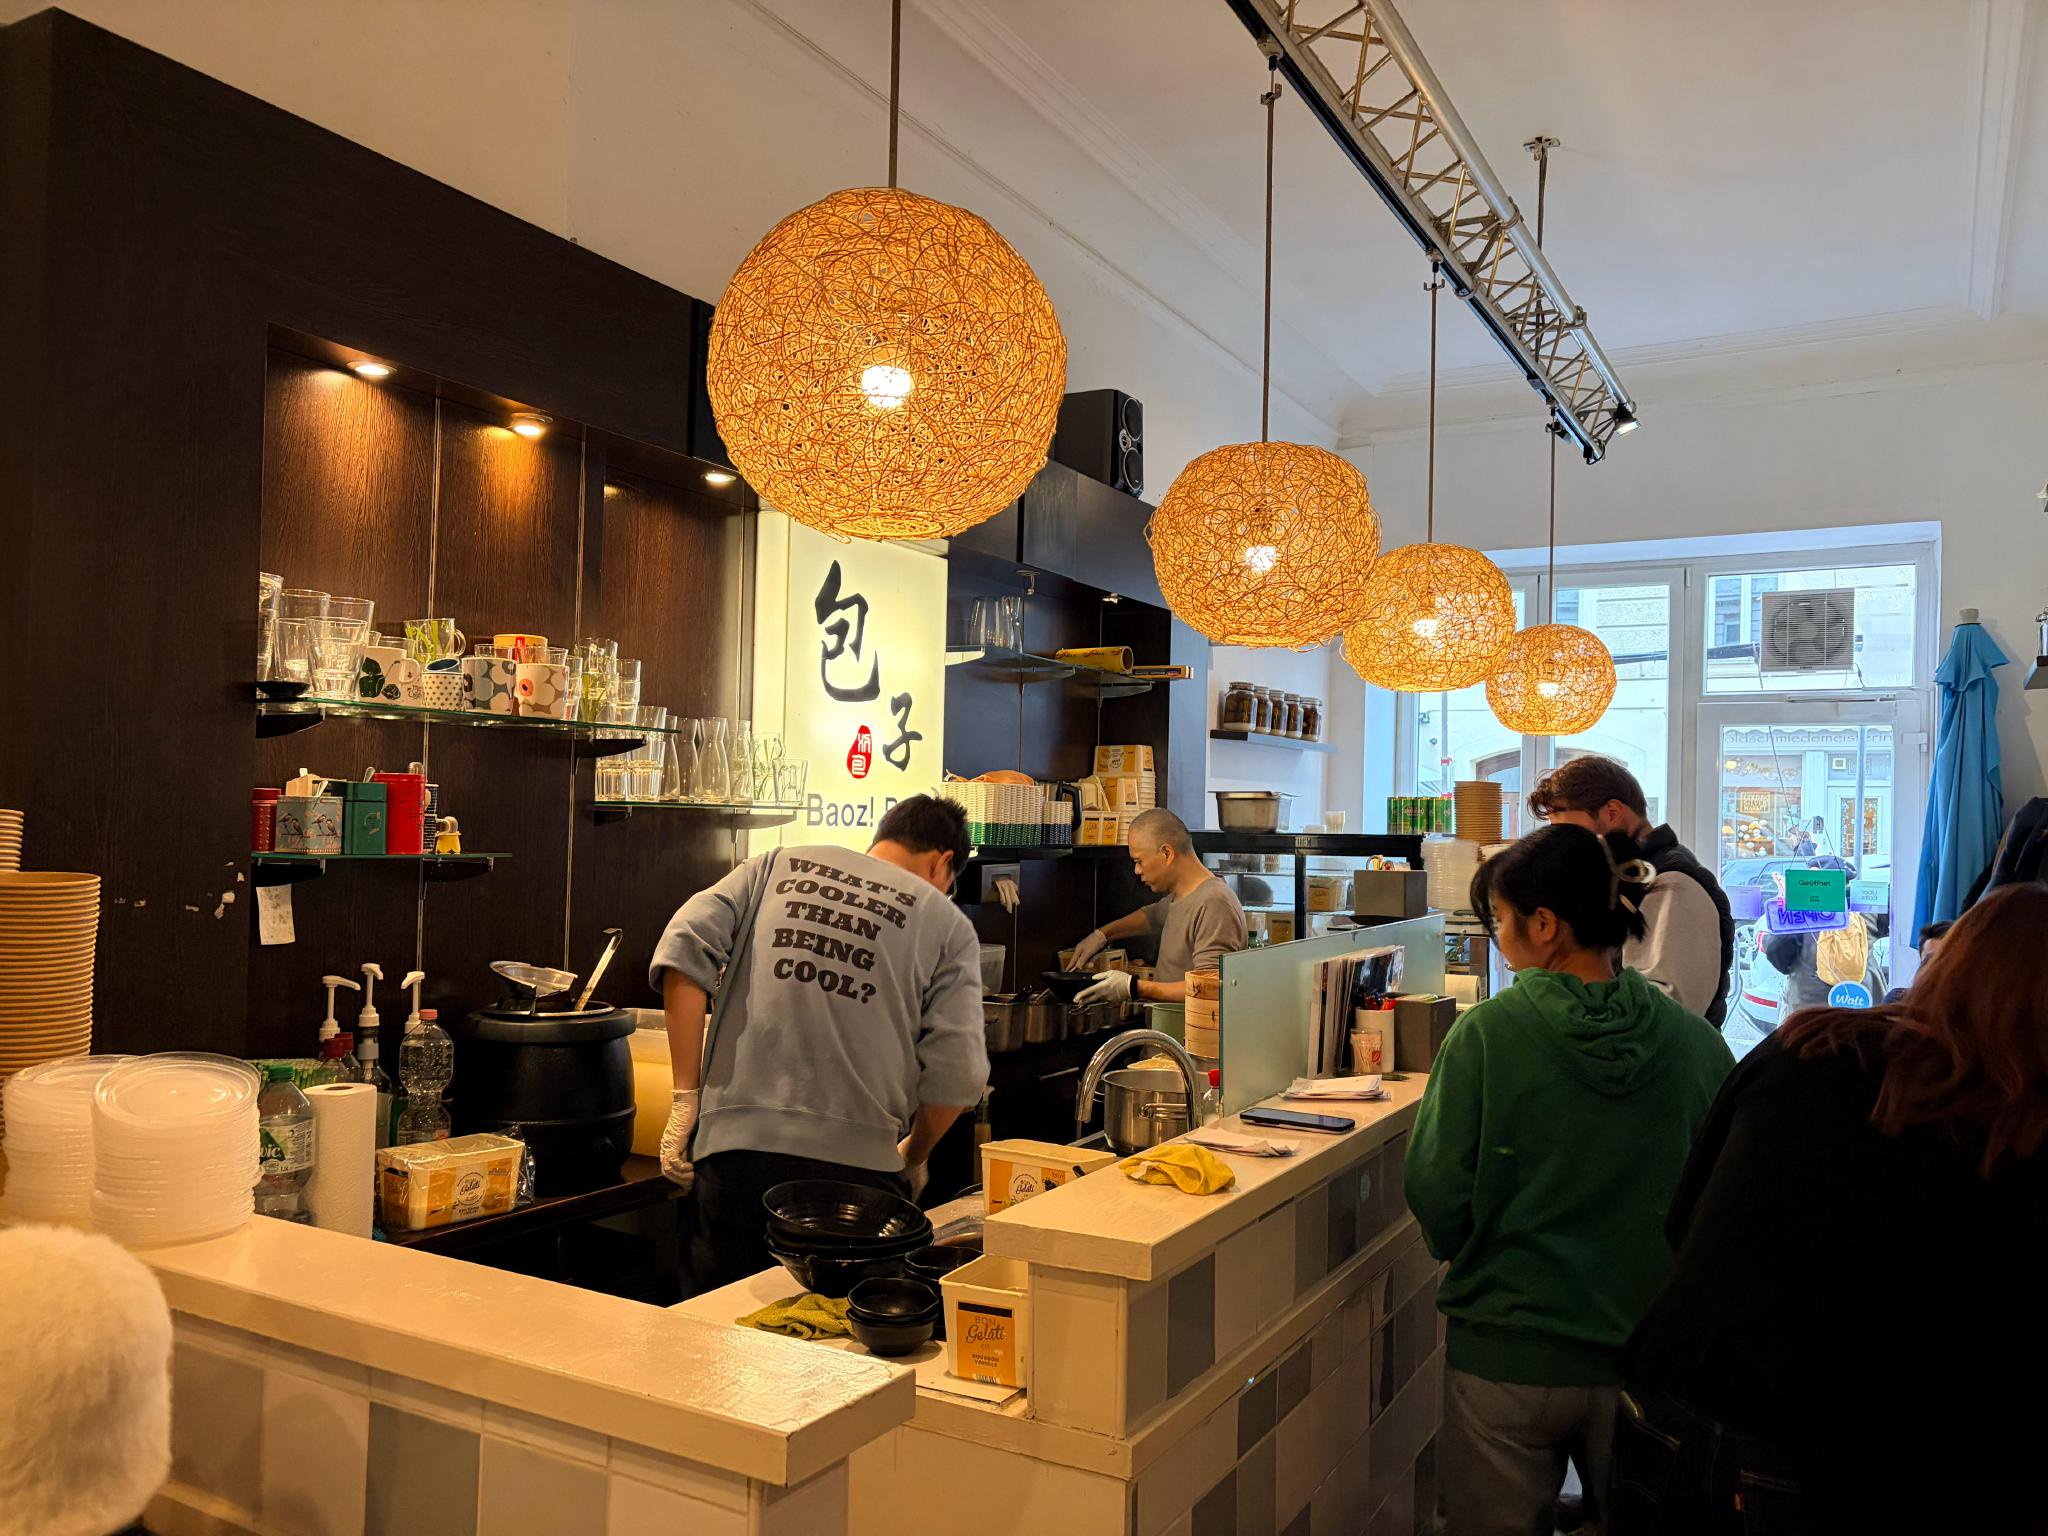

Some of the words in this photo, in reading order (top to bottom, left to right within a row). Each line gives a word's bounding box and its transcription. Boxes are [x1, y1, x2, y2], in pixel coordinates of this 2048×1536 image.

[789, 858, 917, 907] WHAT'S
[776, 879, 907, 929] COOLER
[785, 901, 882, 941] THAN
[772, 928, 876, 972] BEING
[774, 958, 877, 1004] COOL?
[1835, 994, 1865, 1006] Wolt
[966, 1324, 1007, 1343] Gelati
[975, 1316, 996, 1326] BON
